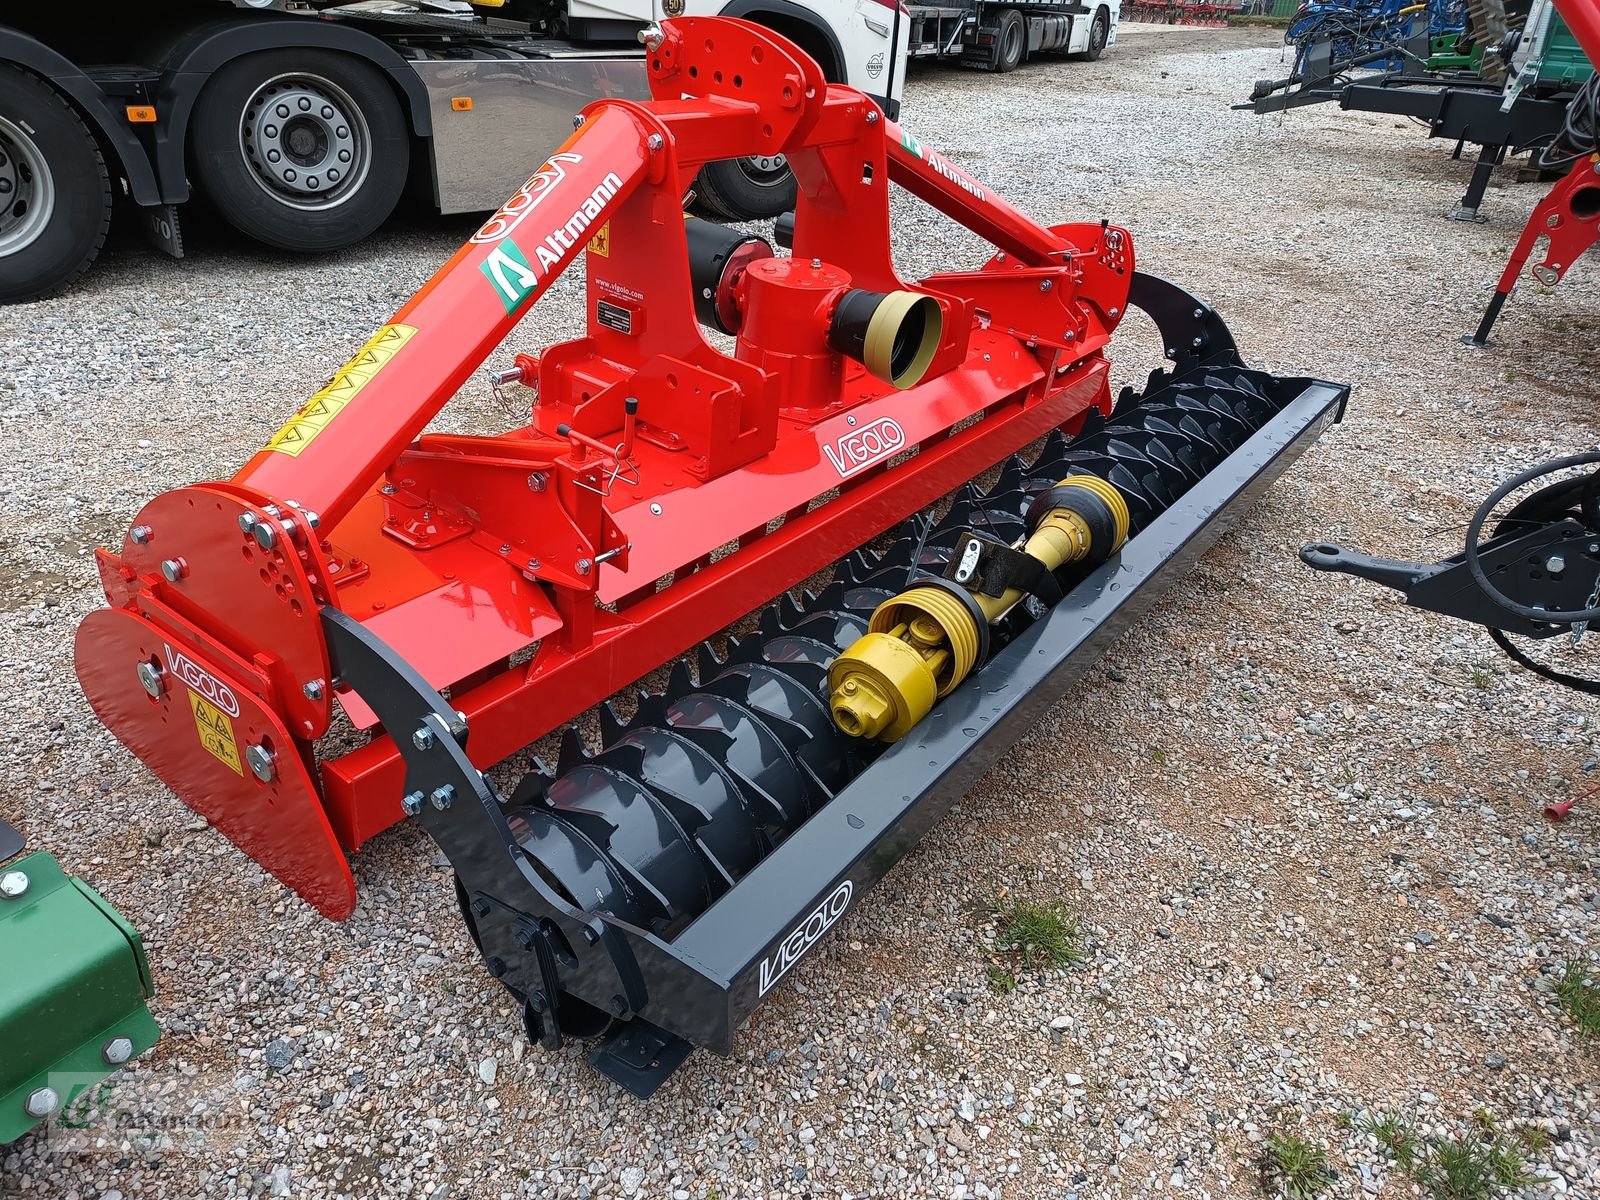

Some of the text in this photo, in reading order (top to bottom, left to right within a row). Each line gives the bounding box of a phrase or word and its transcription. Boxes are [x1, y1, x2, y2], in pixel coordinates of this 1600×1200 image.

[927, 153, 986, 202] Altmann
[534, 172, 624, 274] Altmann
[595, 278, 644, 300] www.vigolo.com
[822, 416, 905, 478] VIGOLO
[163, 642, 240, 718] VIGOLO
[759, 880, 853, 998] VIGOLO
